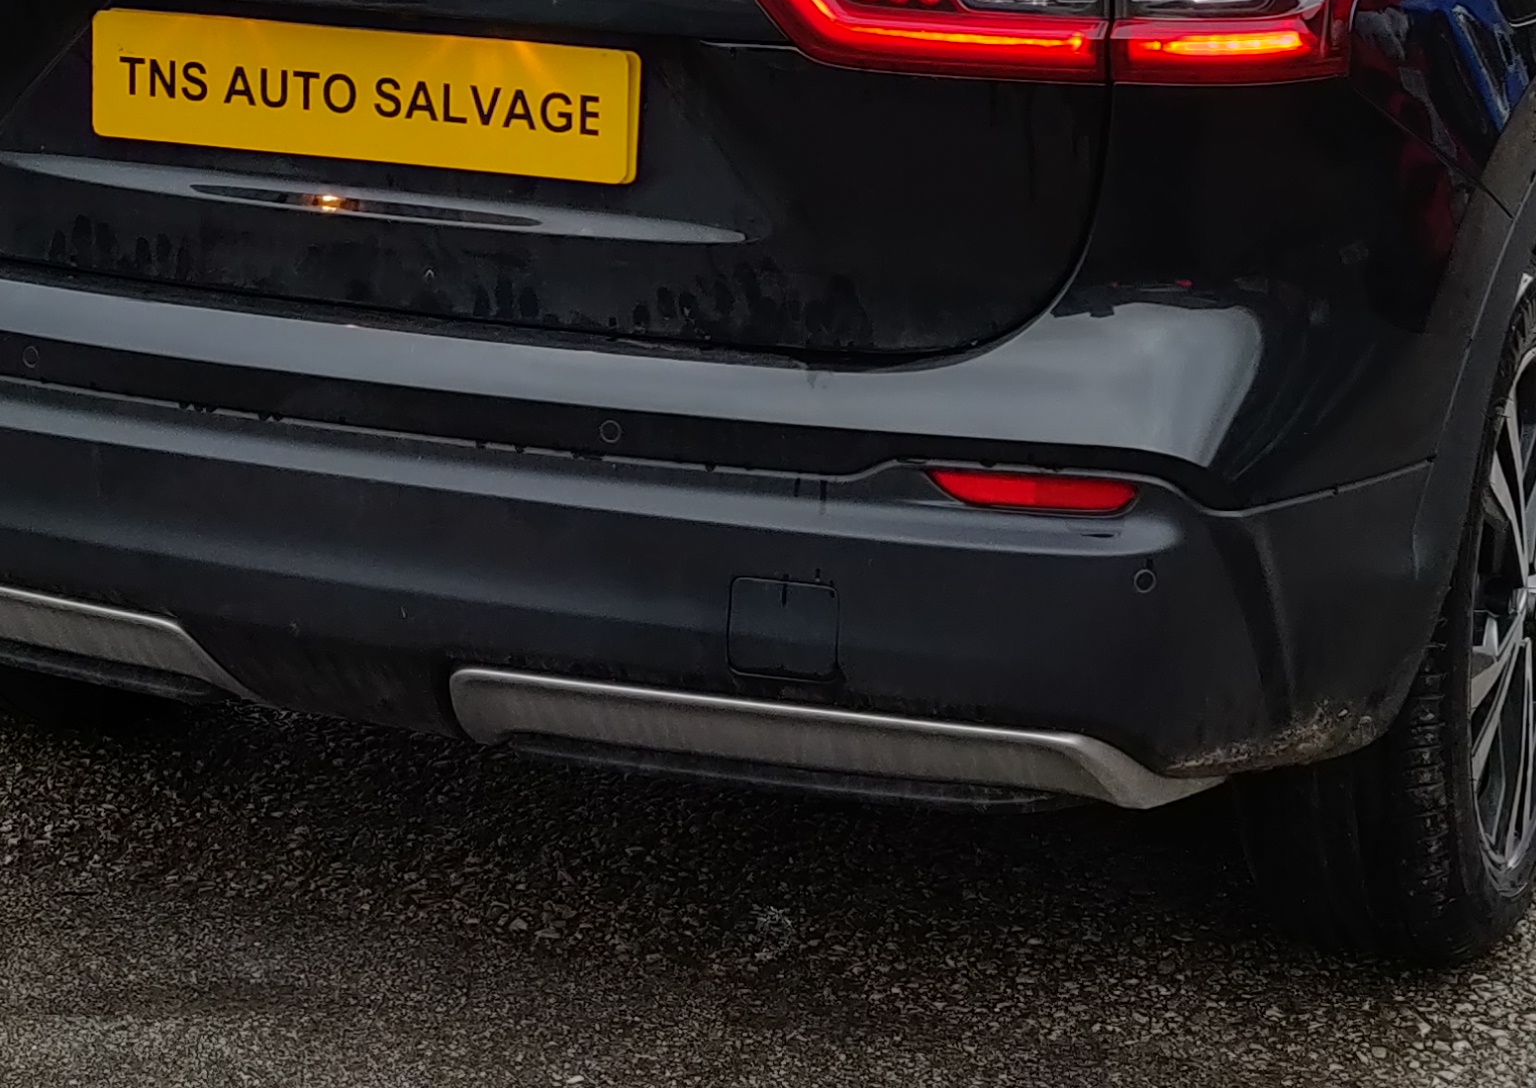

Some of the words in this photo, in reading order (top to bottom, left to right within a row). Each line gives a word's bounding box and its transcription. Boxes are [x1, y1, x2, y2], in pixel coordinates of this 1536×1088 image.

[119, 56, 208, 102] TNS
[223, 65, 357, 114] AUTO
[373, 77, 600, 136] SALVAGE
